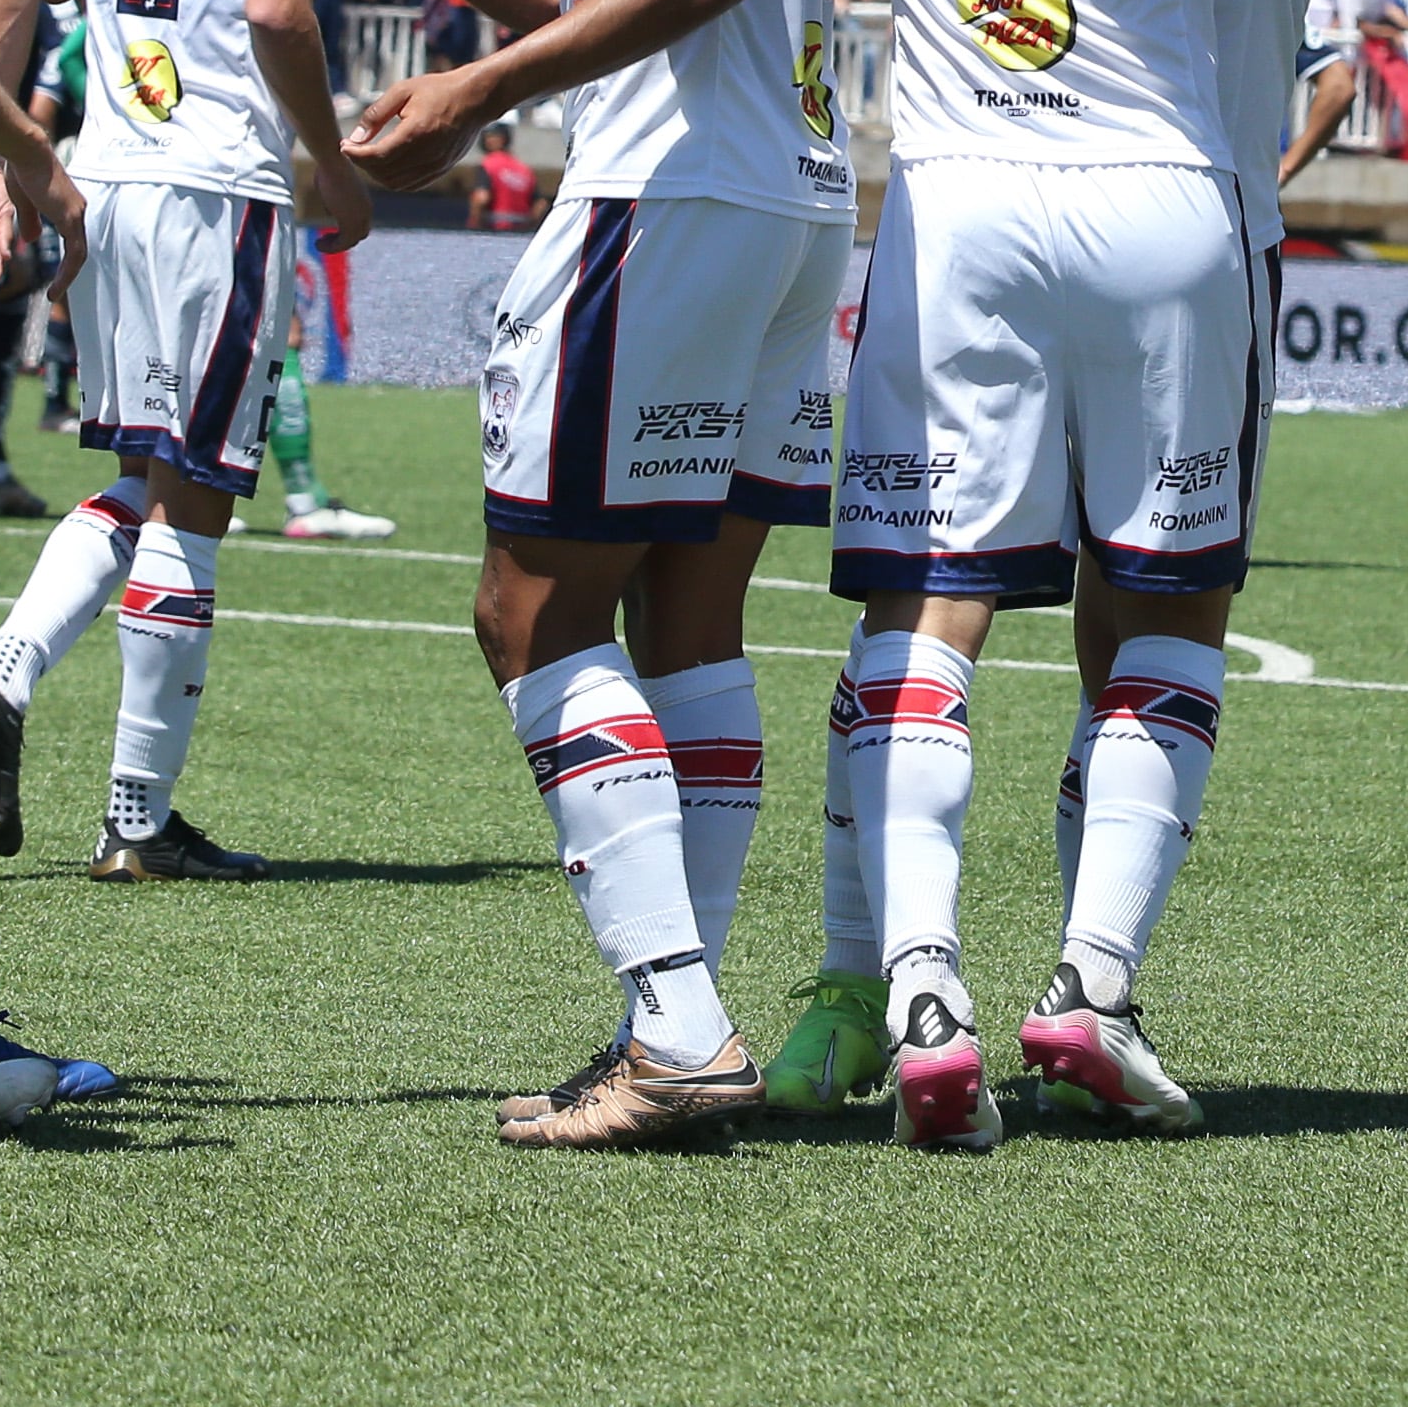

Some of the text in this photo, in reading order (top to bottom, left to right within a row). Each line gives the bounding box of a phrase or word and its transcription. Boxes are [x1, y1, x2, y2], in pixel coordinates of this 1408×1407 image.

[975, 90, 1081, 109] TRAINING
[843, 449, 957, 469] WORLD
[1158, 447, 1231, 474] WORLD
[842, 465, 957, 491] FAST
[1156, 467, 1228, 495] FAST
[839, 504, 953, 528] ROMANINI
[1149, 503, 1228, 531] ROMANINI
